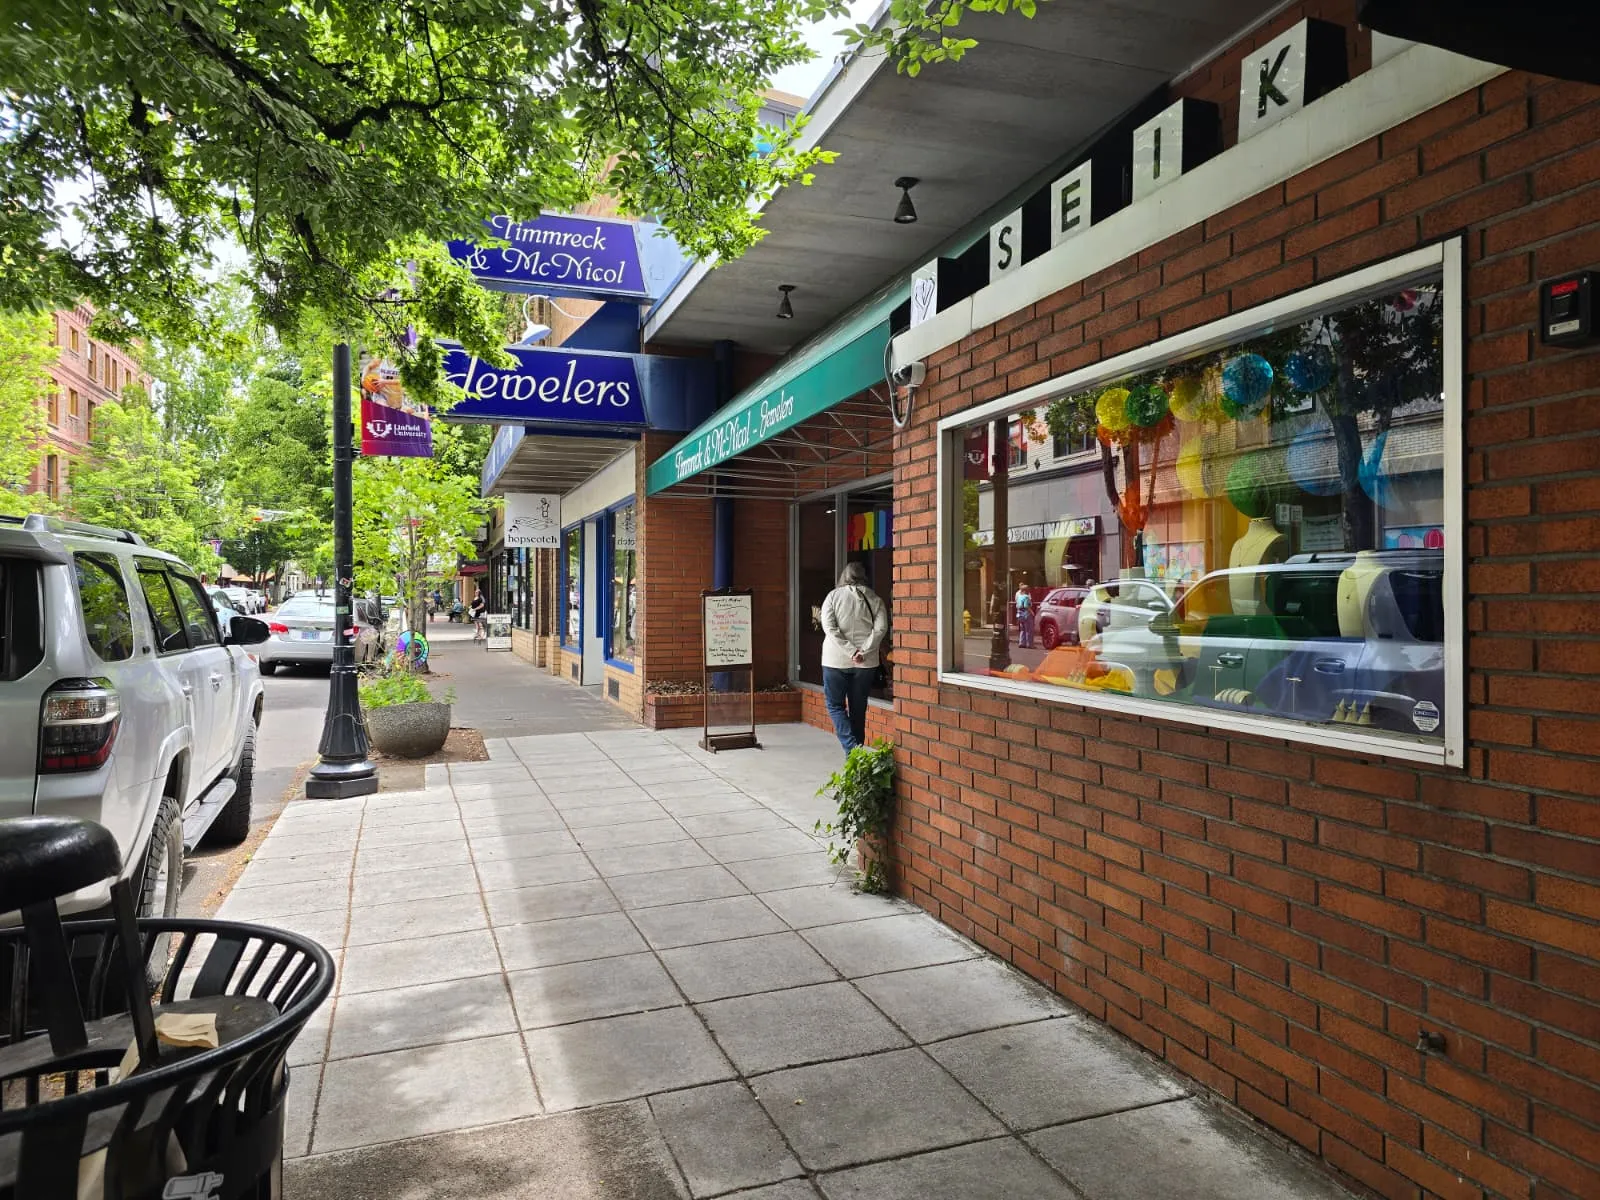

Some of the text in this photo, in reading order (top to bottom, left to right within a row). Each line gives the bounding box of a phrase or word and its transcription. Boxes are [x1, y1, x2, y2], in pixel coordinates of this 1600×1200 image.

[491, 214, 607, 250] Timmreck
[467, 247, 491, 271] &
[759, 390, 794, 438] Jewelers
[394, 423, 420, 432] Linfield
[394, 430, 427, 439] University
[508, 534, 557, 544] hopscotch
